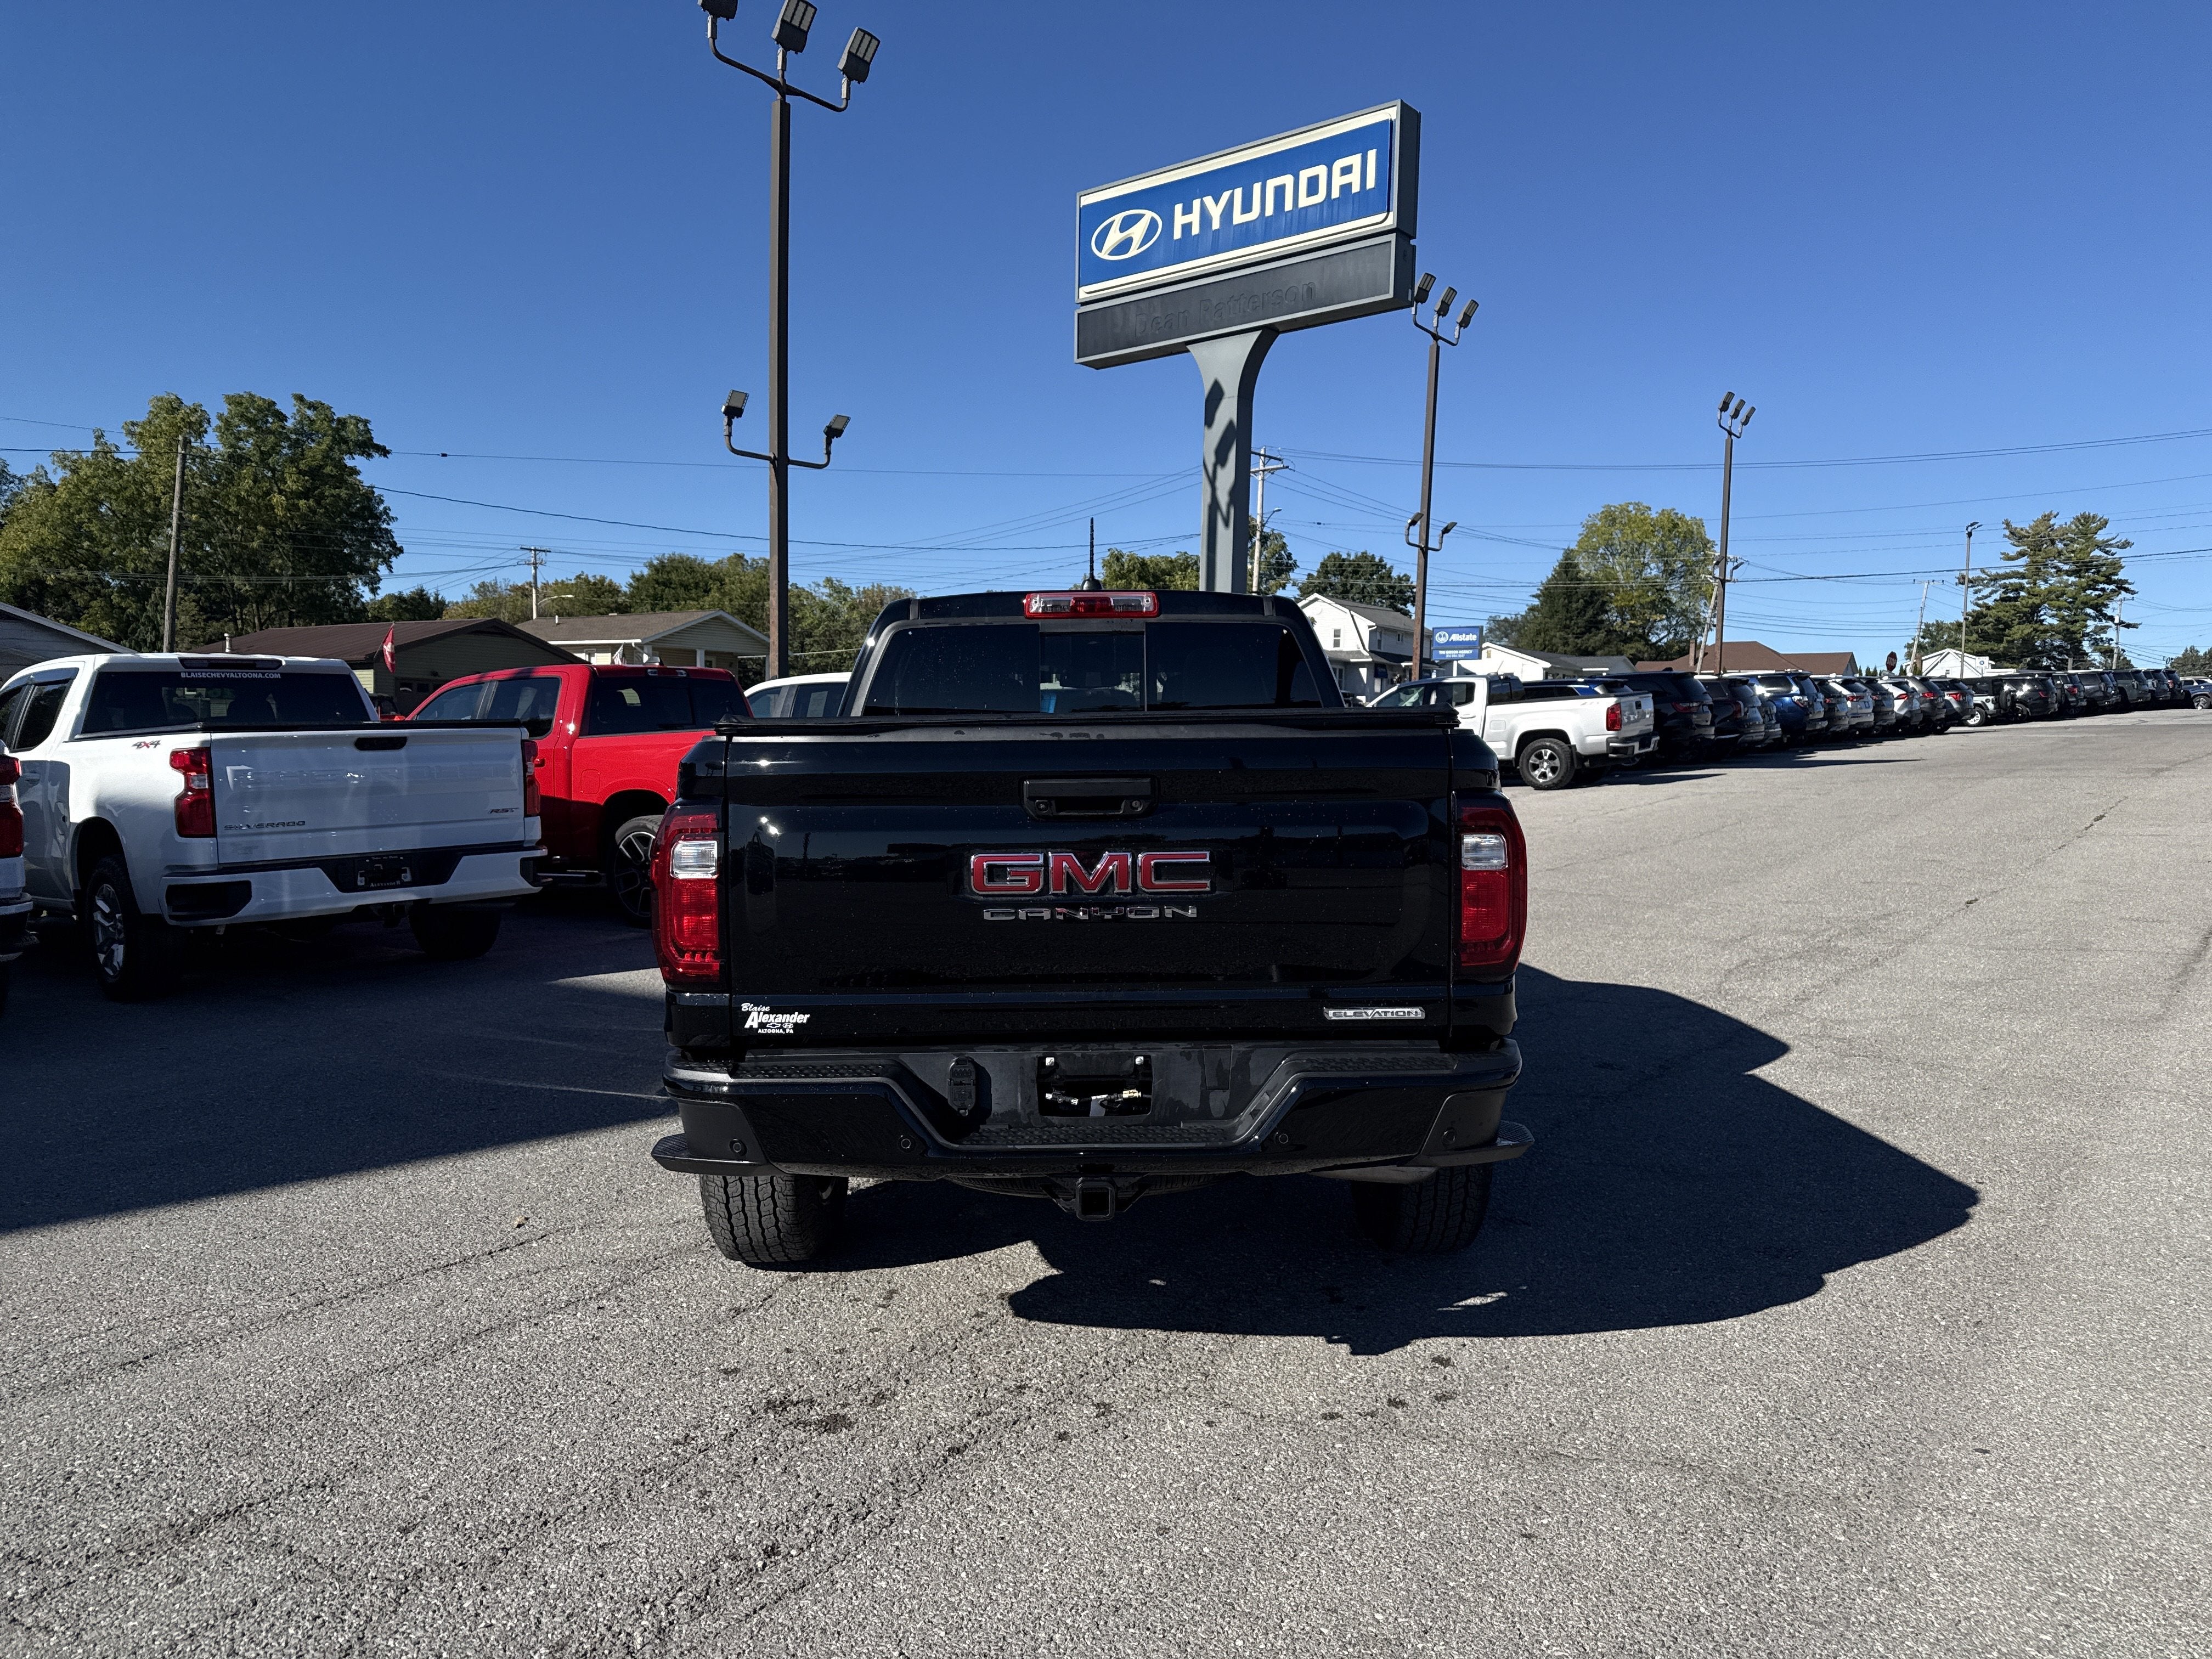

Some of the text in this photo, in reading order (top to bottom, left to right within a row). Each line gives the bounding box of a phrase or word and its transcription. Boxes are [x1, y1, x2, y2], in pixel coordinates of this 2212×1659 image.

[1173, 148, 1377, 240] HYUNDAI
[1135, 280, 1316, 337] Dean Patterson
[1449, 633, 1477, 641] Allstate
[1887, 657, 1897, 666] STOP
[224, 821, 306, 831] SILVERADO
[970, 851, 1210, 894] GMC
[984, 906, 1197, 920] CANYON
[741, 1002, 770, 1012] Blaise
[744, 1011, 810, 1028] Alexander
